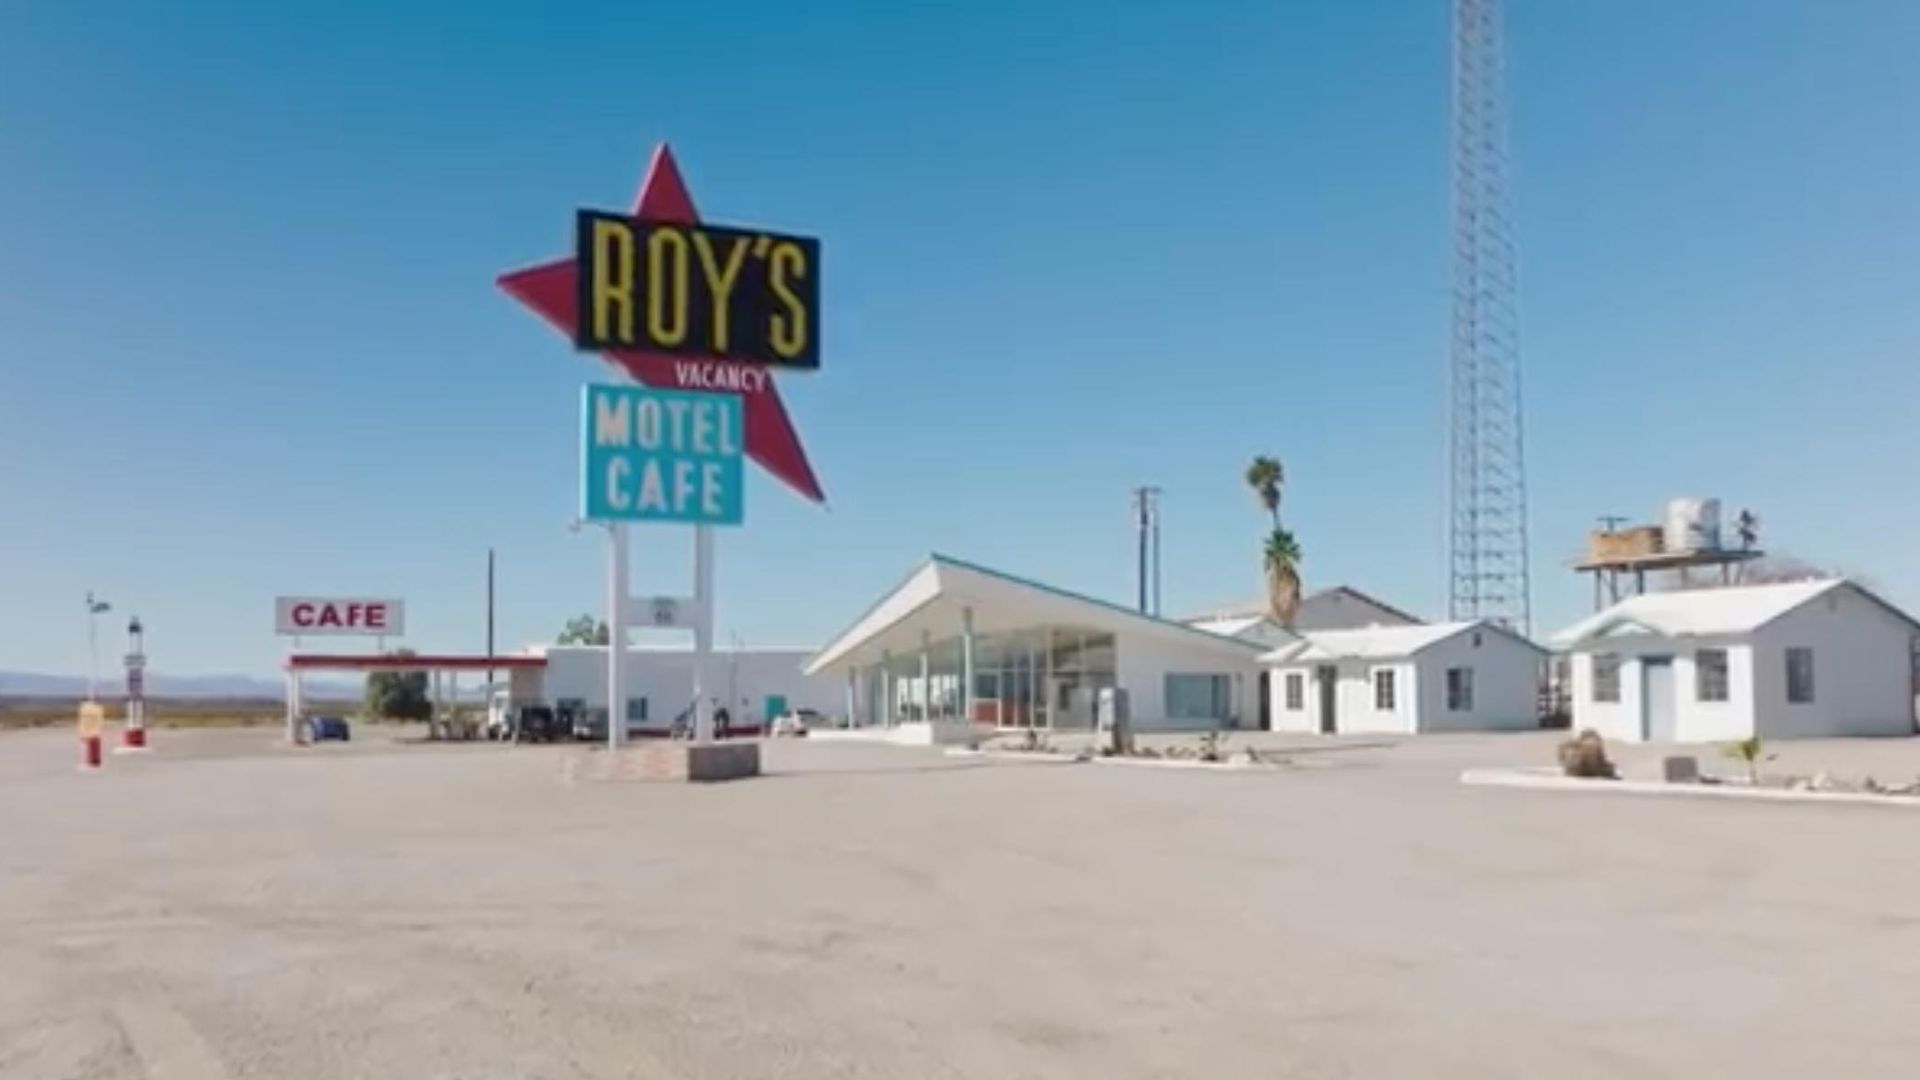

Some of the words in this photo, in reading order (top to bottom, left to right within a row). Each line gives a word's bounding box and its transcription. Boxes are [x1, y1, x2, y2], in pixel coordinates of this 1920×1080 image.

[592, 219, 807, 357] ROY'S
[675, 361, 765, 391] VACANCY
[595, 394, 737, 455] MOTEL
[606, 456, 723, 515] CAFE
[292, 602, 386, 627] CAFE
